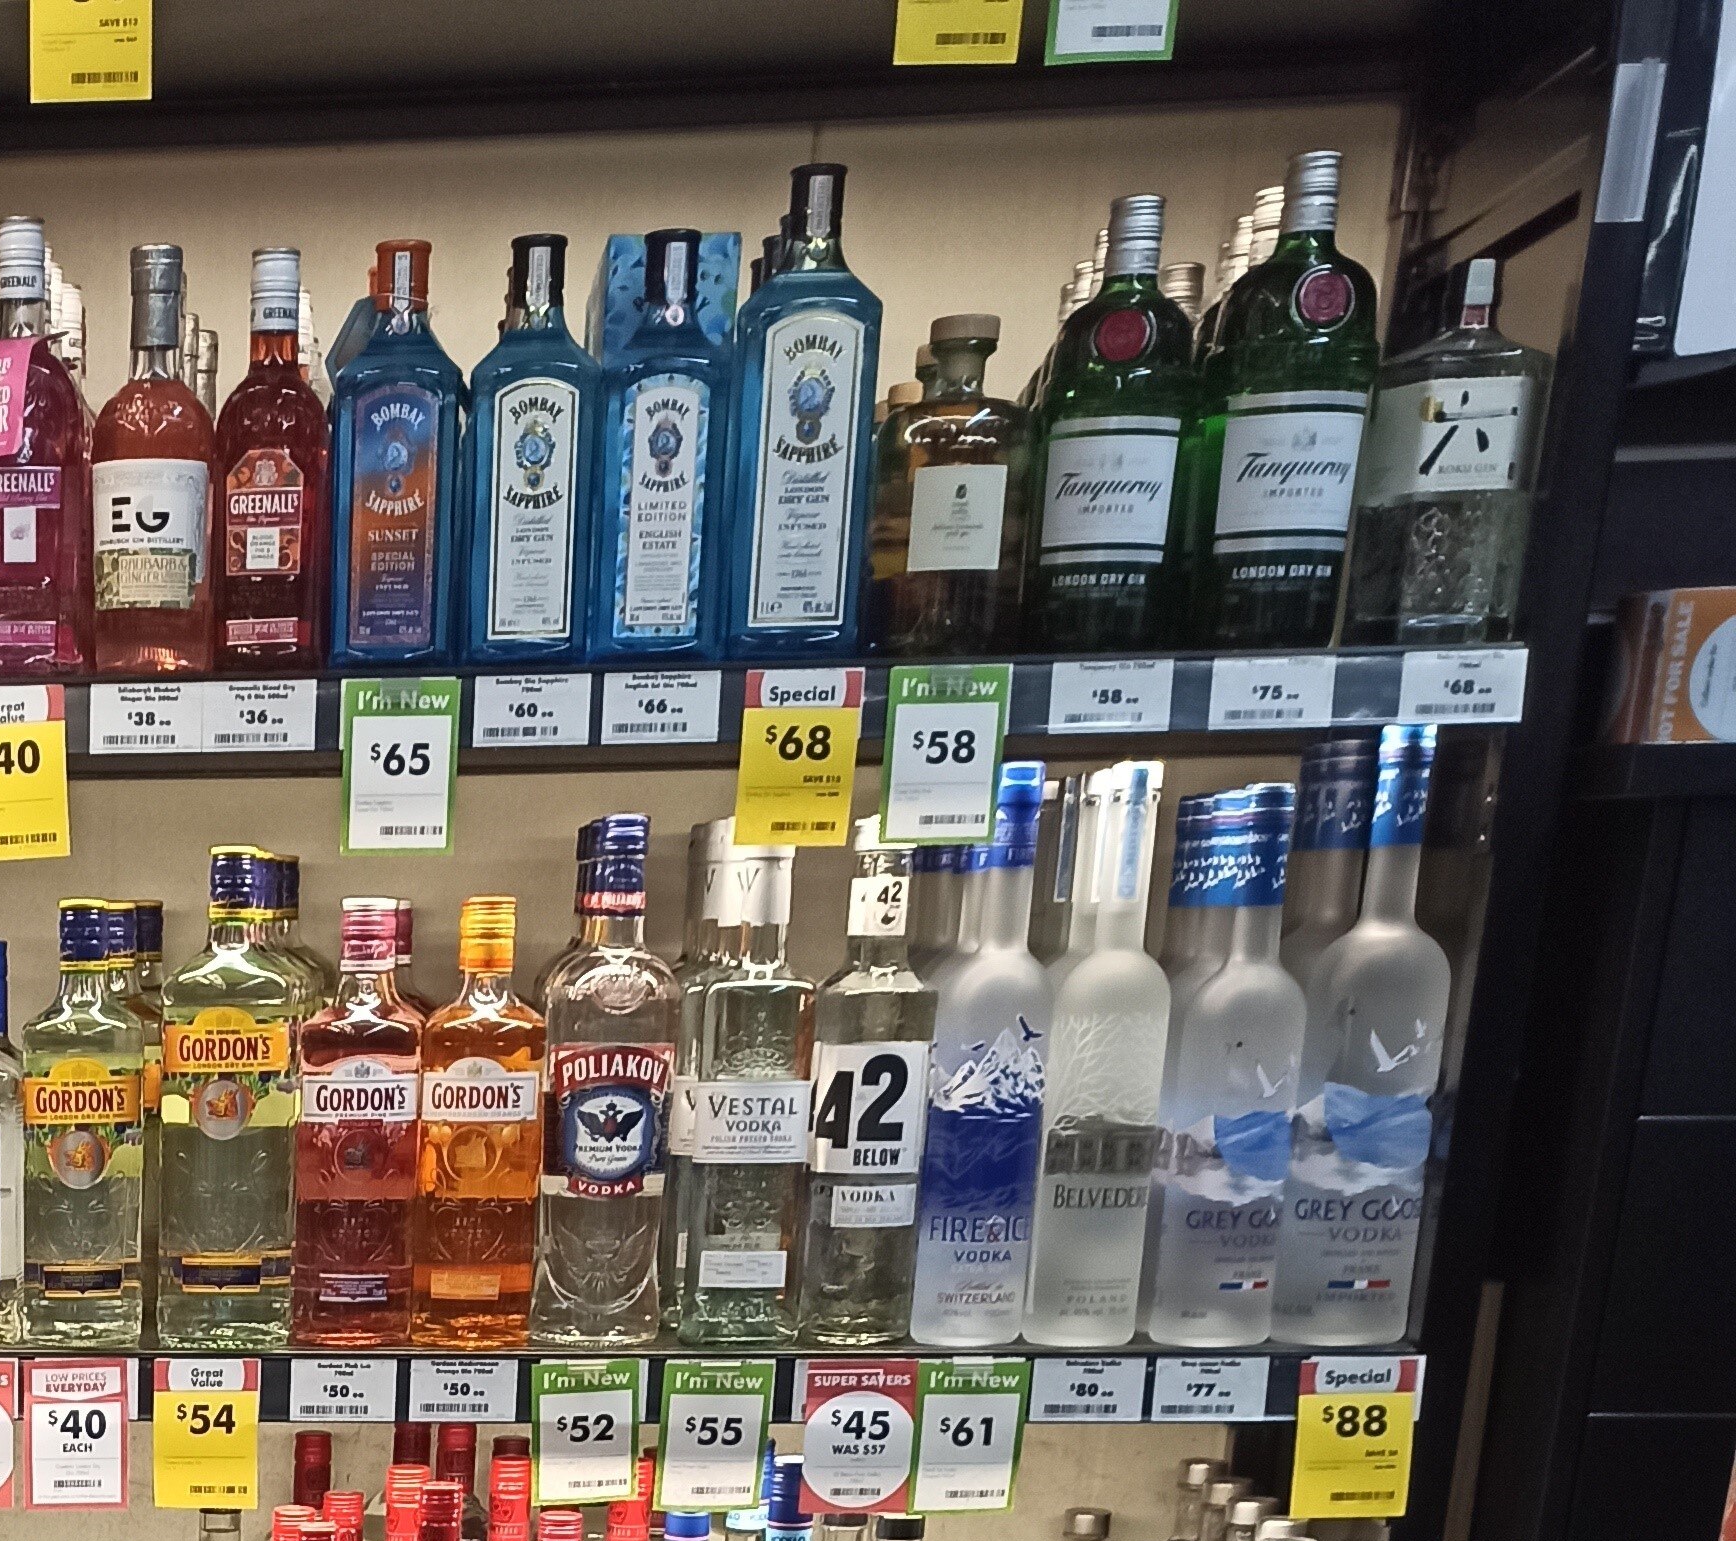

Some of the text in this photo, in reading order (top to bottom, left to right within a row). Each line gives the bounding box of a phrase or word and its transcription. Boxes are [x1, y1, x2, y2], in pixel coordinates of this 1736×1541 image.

[784, 335, 847, 362] BOMBAY
[369, 402, 426, 430] BOMBAY
[509, 397, 564, 424] BOMBAY
[646, 398, 691, 421] BOMBAY
[772, 435, 844, 464] SAPPHIRE
[1236, 453, 1352, 484] Tanqueray
[638, 473, 689, 493] SAPPHIRE
[1055, 472, 1163, 502] Tanqueray
[365, 492, 425, 518] SAPPHIRE
[502, 484, 564, 510] SAPPHIRE
[637, 501, 687, 511] LIMITED
[637, 512, 687, 522] EDITION
[367, 529, 419, 542] SUNSET
[638, 530, 682, 539] ENGLISH
[642, 540, 677, 549] ESTATE
[371, 552, 415, 561] SPECIAL
[371, 561, 415, 572] EDITION
[509, 703, 538, 718] $60
[765, 724, 833, 762] $68
[913, 730, 976, 765] $58
[370, 743, 431, 776] $65
[179, 1035, 270, 1063] GORDON'S
[562, 1054, 665, 1087] POLIAKOV
[35, 1086, 126, 1114] GORDON'S
[315, 1084, 406, 1112] GORDON'S
[431, 1082, 522, 1110] GORDON'S
[708, 1096, 799, 1118] VESTAL
[817, 1053, 908, 1149] 42
[725, 1119, 782, 1133] VODKA
[853, 1148, 901, 1166] BELOW
[578, 1180, 636, 1195] VODKA
[841, 1189, 895, 1203] VODKA
[953, 1250, 1013, 1263] VODKA
[45, 1372, 107, 1383] LOW PRICES
[191, 1368, 224, 1378] Great
[191, 1377, 223, 1389] Value
[814, 1373, 911, 1388] SUPER SAVERS
[1324, 1368, 1391, 1389] Special
[45, 1382, 107, 1393] EVERYDAY
[323, 1384, 350, 1398] $50
[1069, 1384, 1099, 1398] $80
[48, 1409, 106, 1440] $40
[177, 1404, 235, 1435] $54
[557, 1414, 614, 1443] $52
[831, 1409, 891, 1441] $45
[1322, 1404, 1388, 1438] $88
[686, 1417, 743, 1445] $55
[939, 1416, 994, 1447] $61
[62, 1443, 93, 1454] EACH
[831, 1443, 885, 1456] WAS $57
